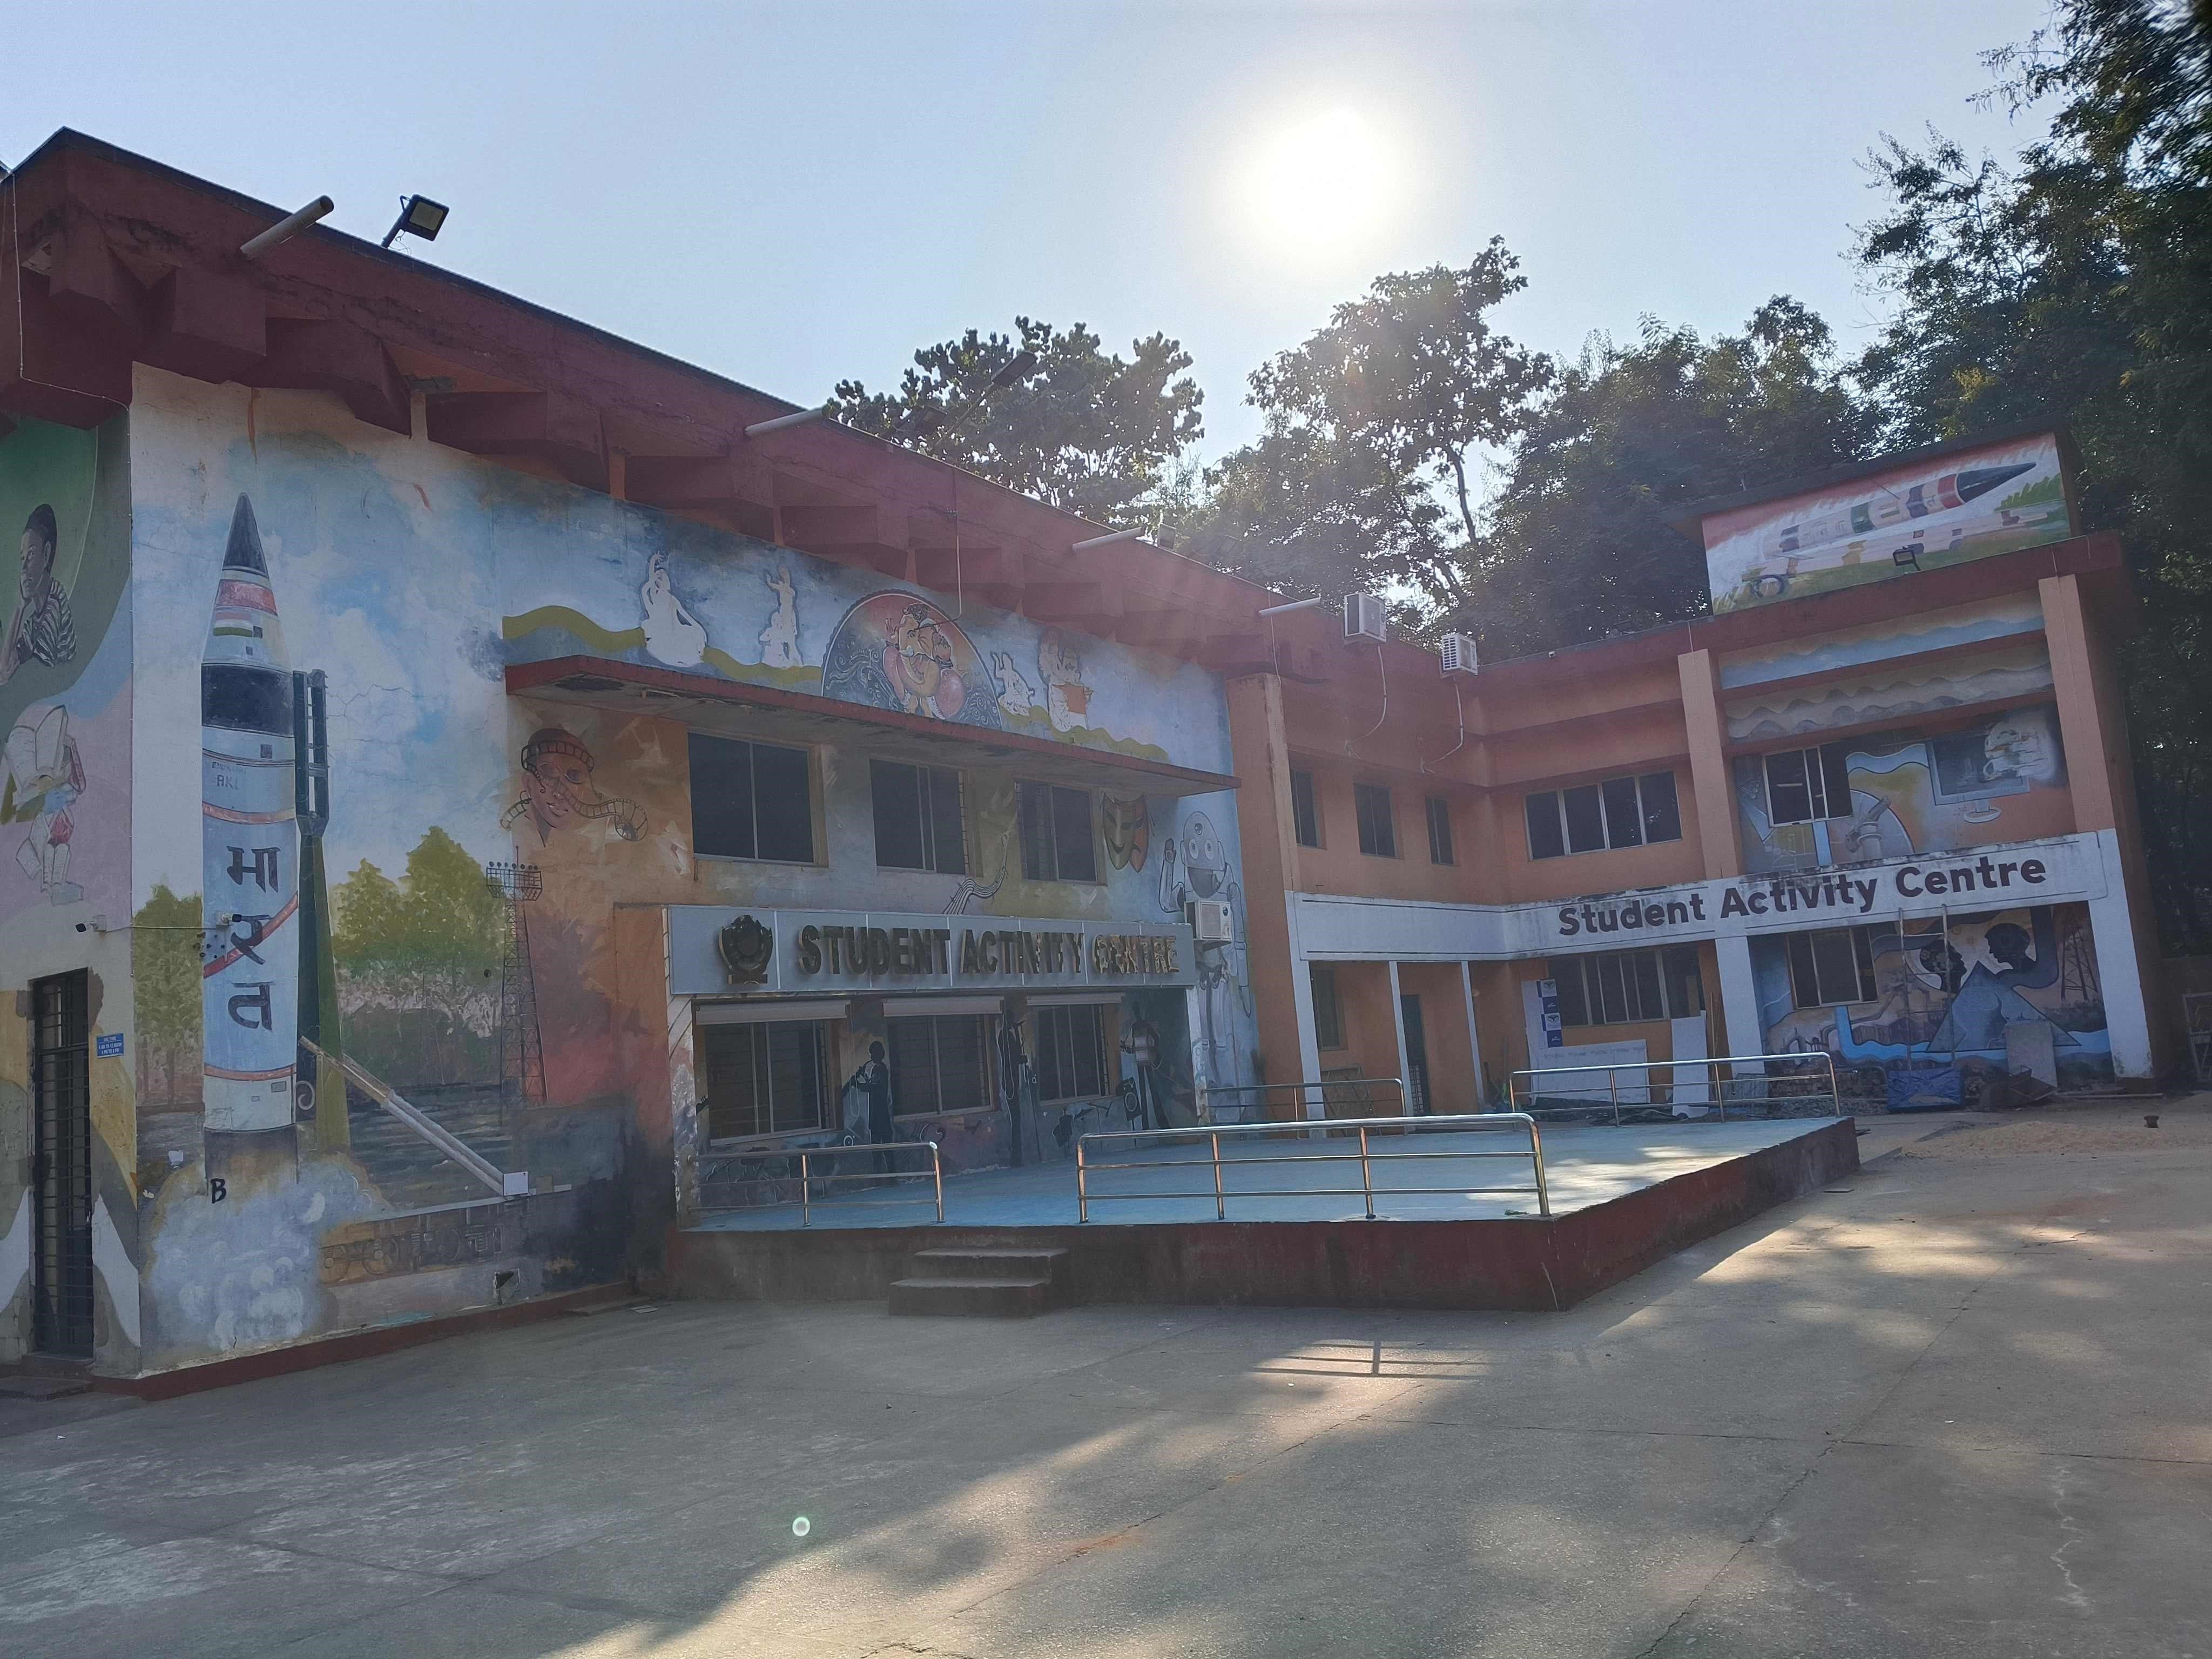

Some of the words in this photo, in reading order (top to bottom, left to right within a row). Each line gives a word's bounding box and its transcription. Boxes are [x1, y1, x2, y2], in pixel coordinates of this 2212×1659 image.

[1559, 894, 1706, 935] Student
[1721, 875, 1878, 918] Activity
[1896, 857, 2047, 898] Centre
[799, 925, 950, 975] STUDENT
[960, 929, 1084, 974] ACTIVITY
[1091, 934, 1179, 974] CENTRE
[210, 1178, 227, 1204] B
